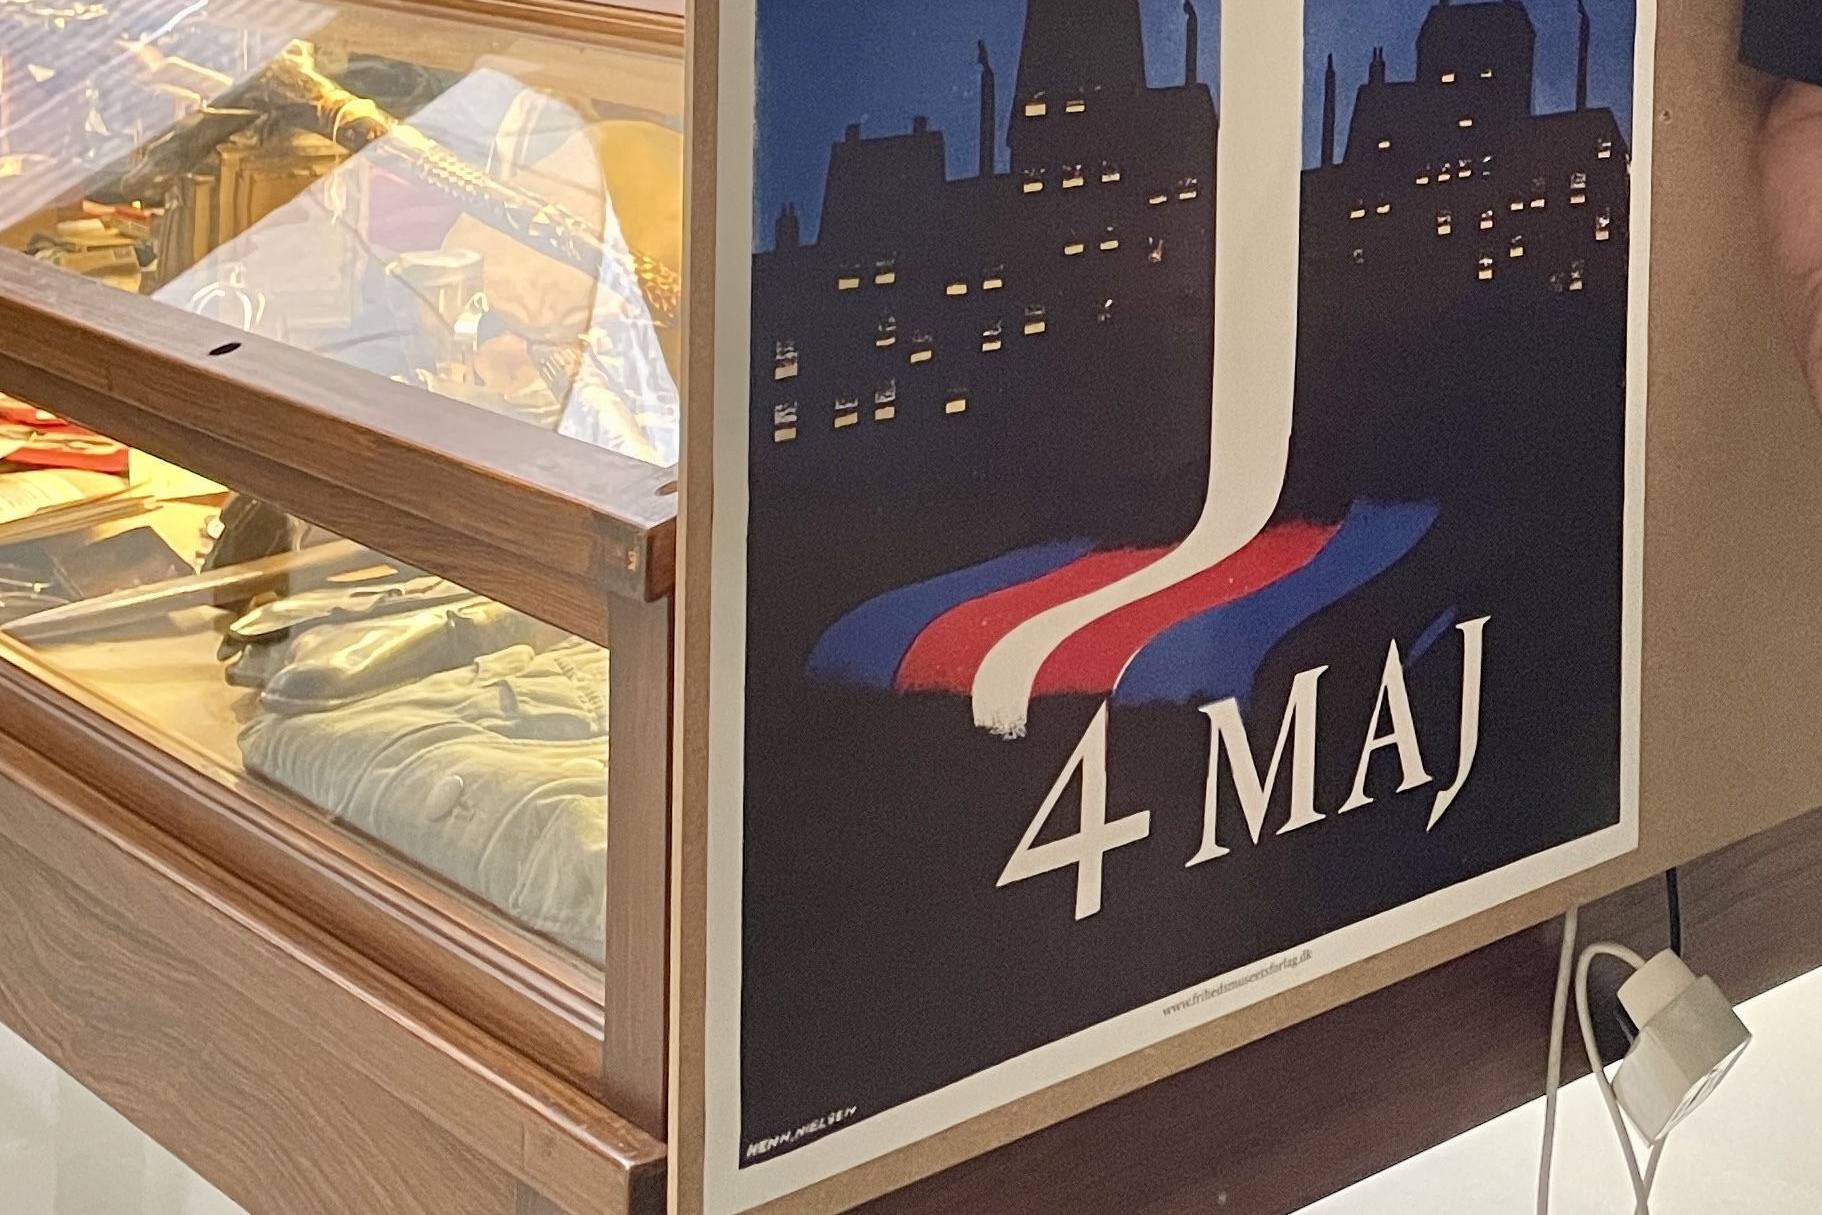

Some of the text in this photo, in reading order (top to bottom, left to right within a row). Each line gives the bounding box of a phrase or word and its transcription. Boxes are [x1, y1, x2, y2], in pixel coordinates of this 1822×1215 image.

[995, 615, 1492, 921] 4 MAJ
[1162, 948, 1313, 1016] www.frihedsmuseetsforlag.dk
